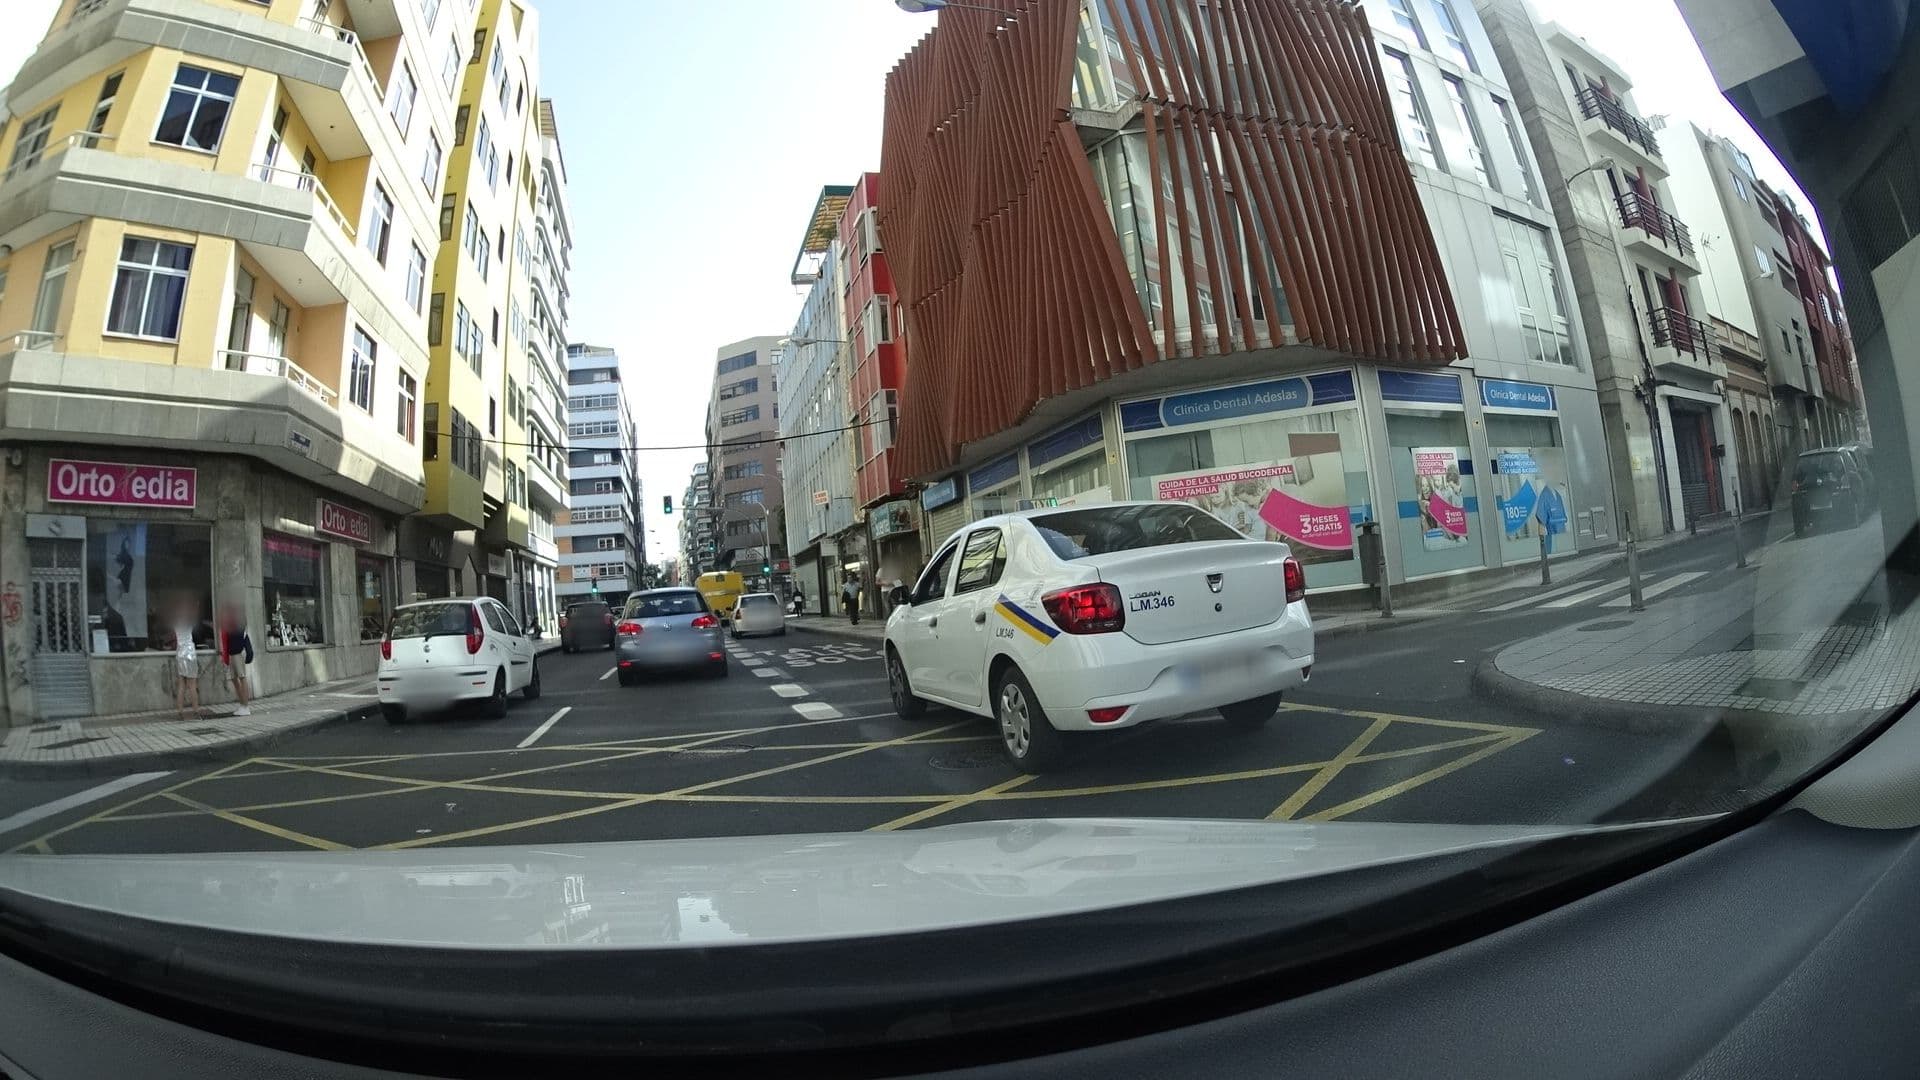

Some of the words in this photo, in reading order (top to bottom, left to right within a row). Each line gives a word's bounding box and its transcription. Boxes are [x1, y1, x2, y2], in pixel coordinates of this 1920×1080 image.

[1173, 402, 1210, 416] Clínica
[1213, 396, 1251, 410] Dental
[1254, 390, 1297, 404] Adeslas
[57, 463, 189, 501] Ortoedia
[1160, 481, 1184, 490] CUIDA
[1186, 479, 1197, 487] DE
[1198, 477, 1209, 485] LA
[1210, 473, 1237, 484] SALUD
[1238, 466, 1292, 479] BUCODENTAL
[1160, 490, 1172, 499] DE
[1173, 489, 1184, 498] TU
[1185, 486, 1218, 496] FAMILIA
[1031, 499, 1053, 508] TAXI
[1445, 512, 1451, 523] 3
[1505, 506, 1519, 519] 180
[1300, 517, 1312, 534] 3
[1312, 514, 1339, 524] MESES
[1312, 522, 1343, 532] GRATIS
